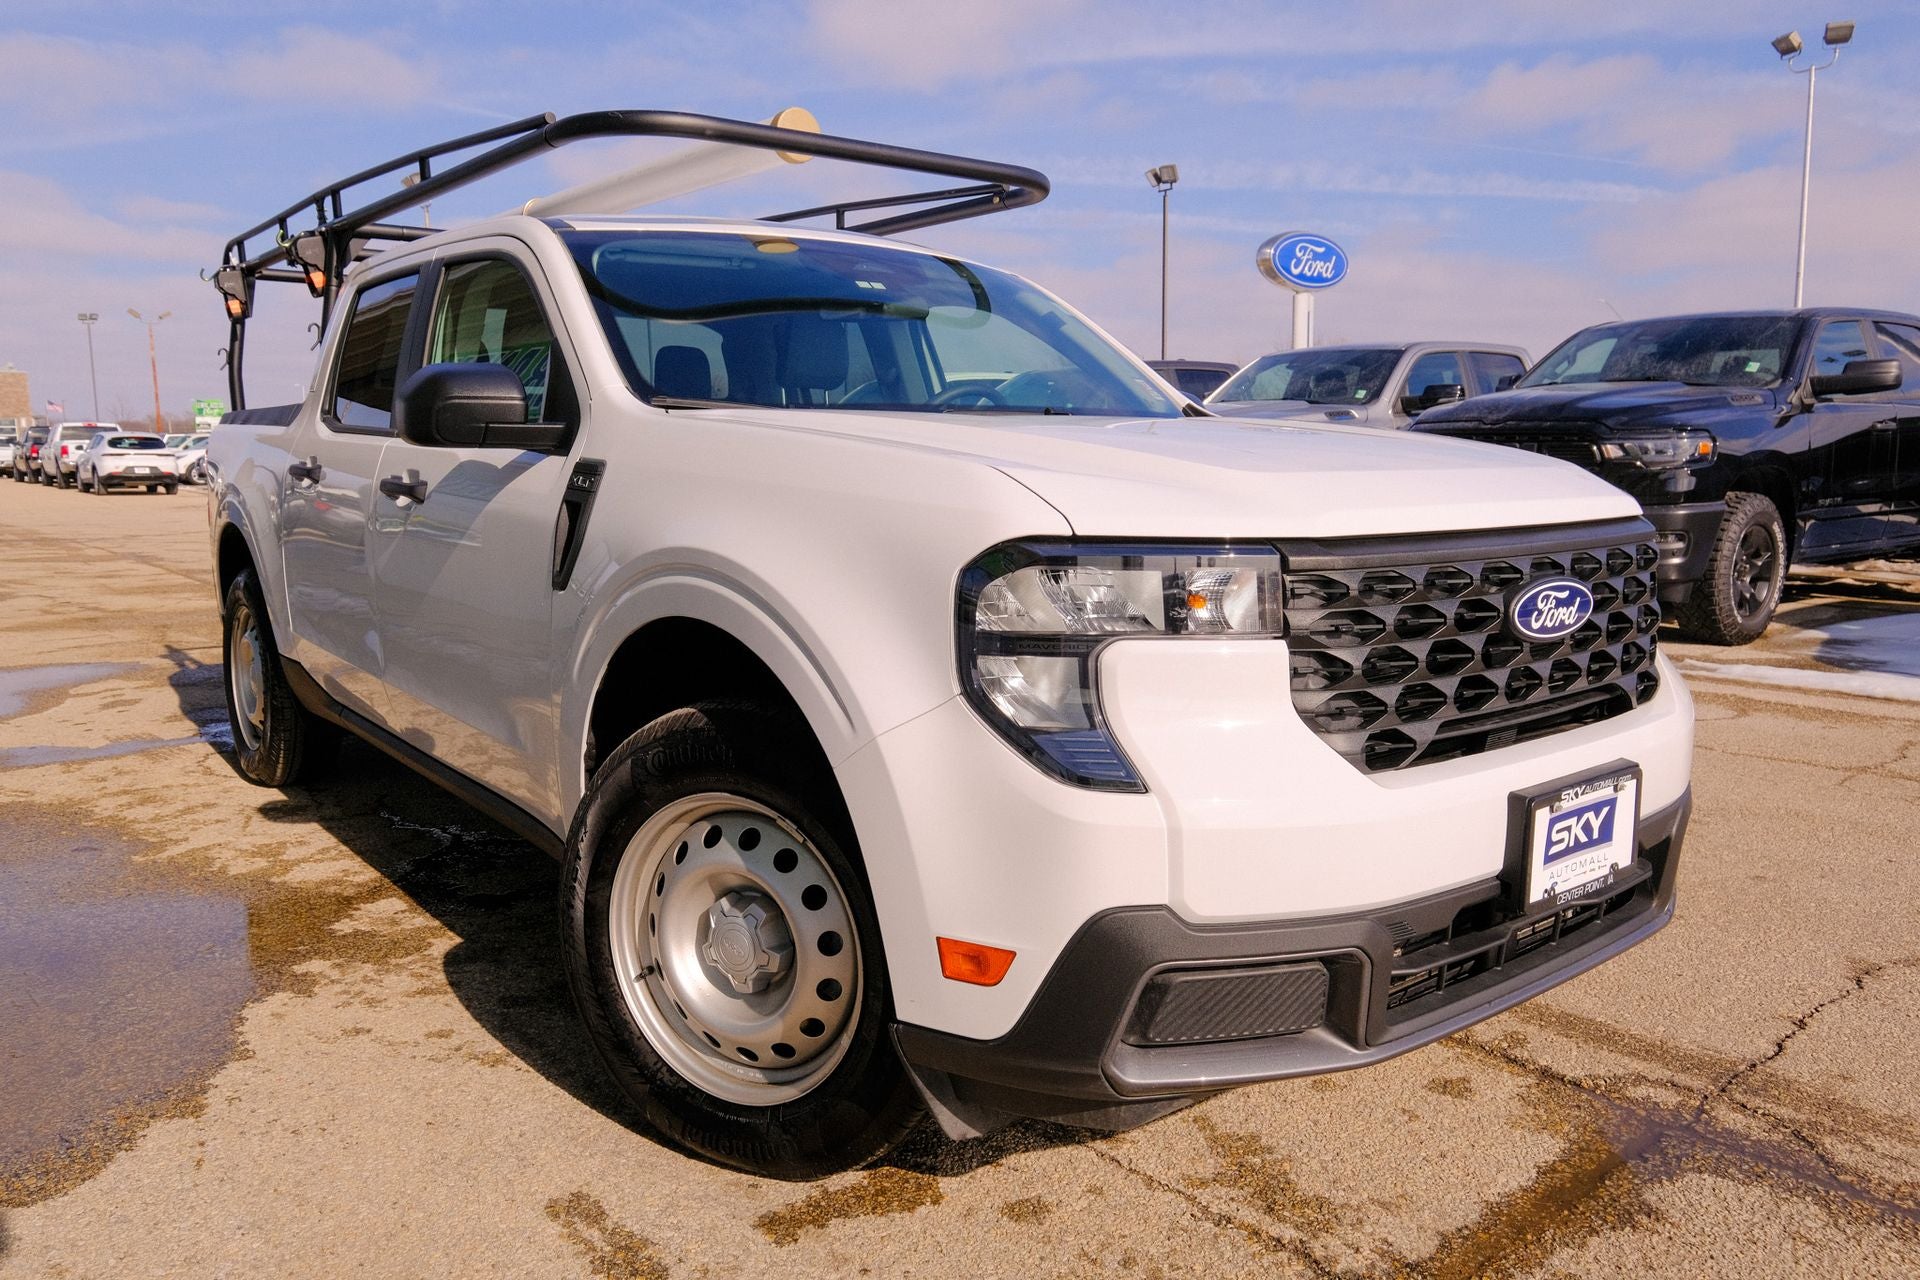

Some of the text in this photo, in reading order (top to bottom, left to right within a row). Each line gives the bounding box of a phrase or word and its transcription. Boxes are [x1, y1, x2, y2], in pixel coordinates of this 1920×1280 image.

[1290, 242, 1337, 279] Ford
[1531, 590, 1581, 630] Ford
[1548, 806, 1611, 855] SKY
[1549, 852, 1609, 880] AUTOMALL
[1556, 886, 1584, 905] CENTER
